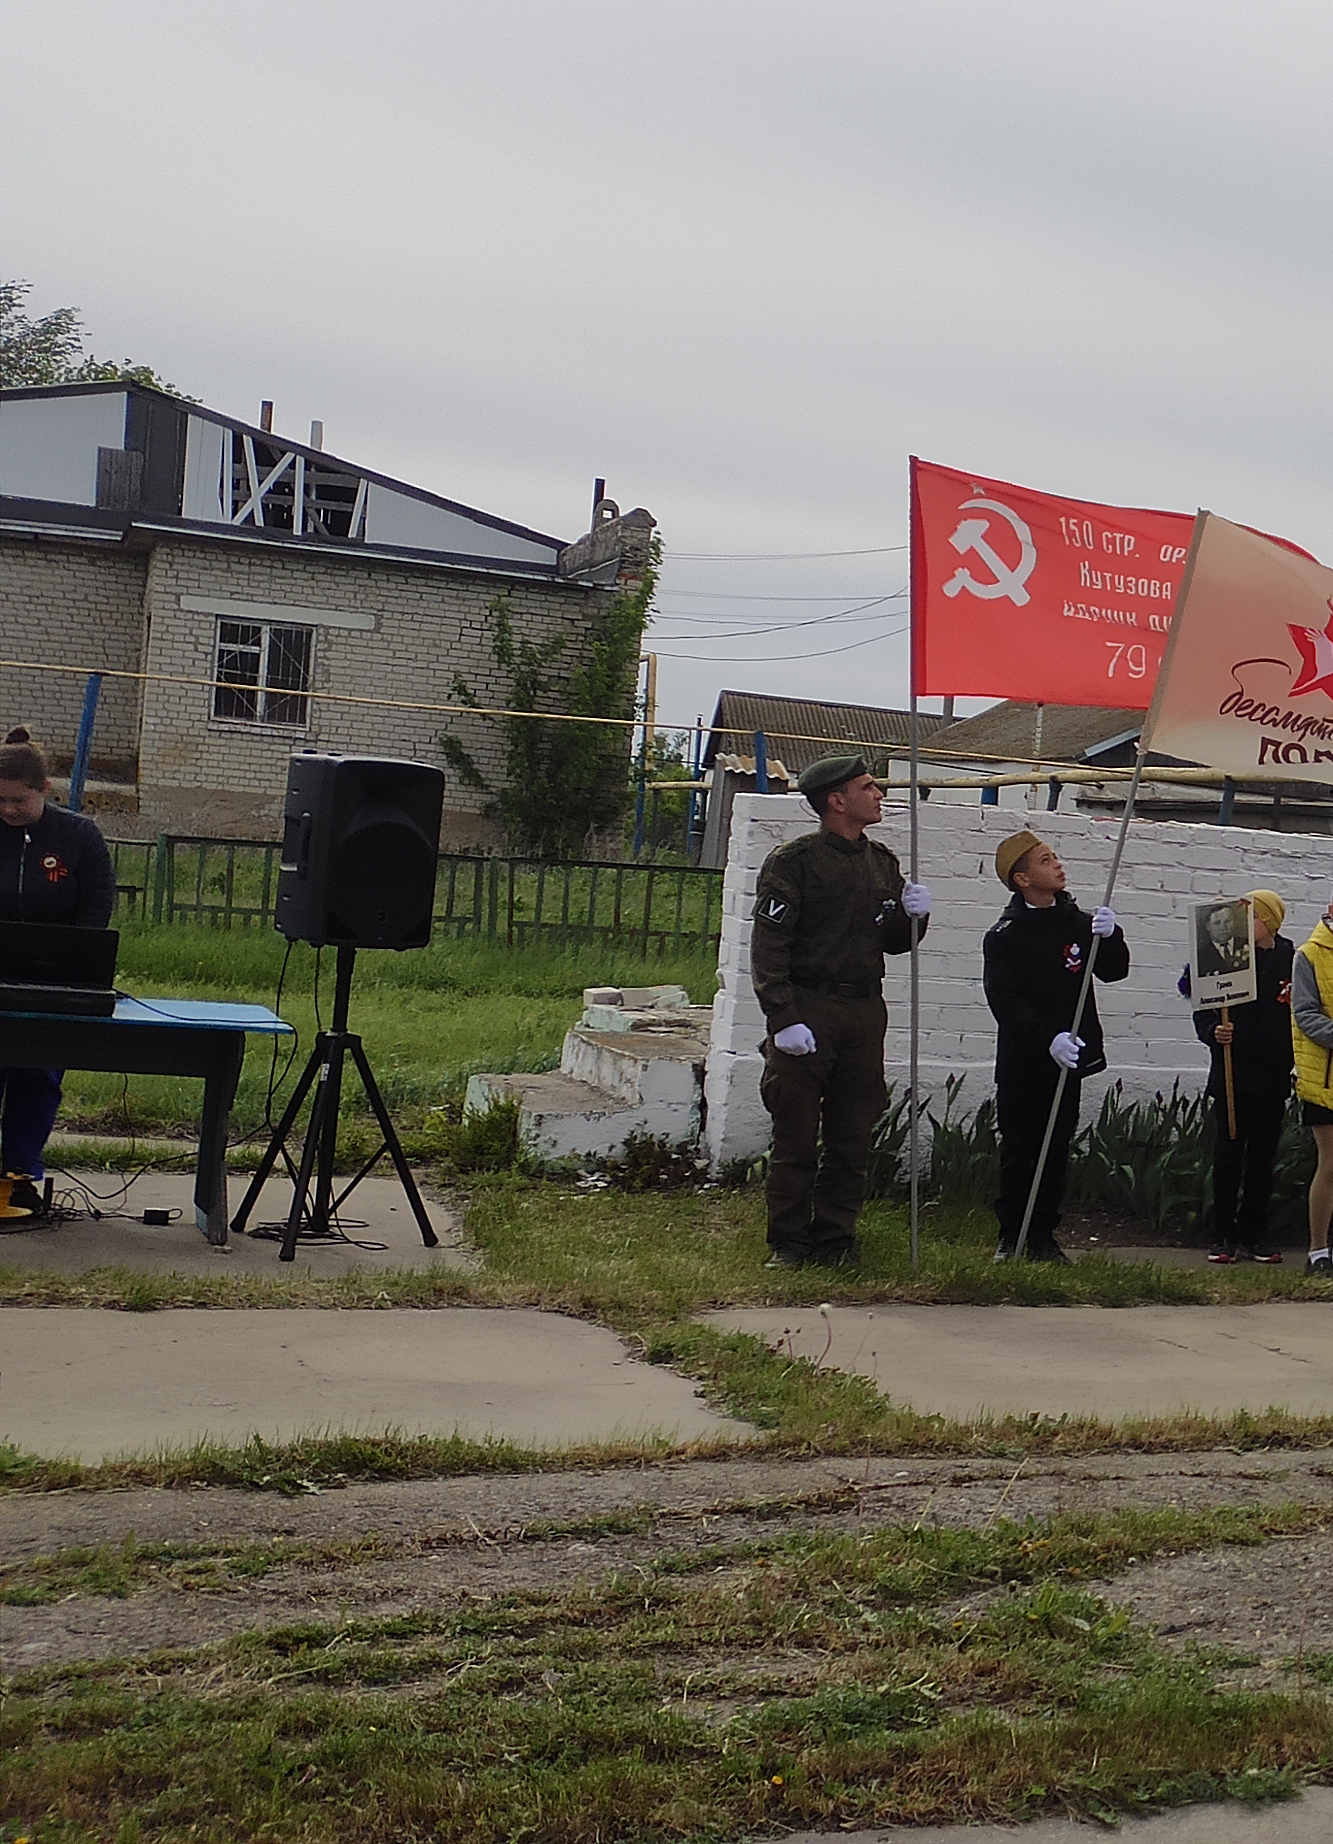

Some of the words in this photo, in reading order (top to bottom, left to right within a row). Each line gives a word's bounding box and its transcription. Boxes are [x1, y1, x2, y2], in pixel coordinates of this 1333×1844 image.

[1059, 517, 1094, 550] 150
[1105, 641, 1146, 679] 79
[769, 899, 785, 916] V
